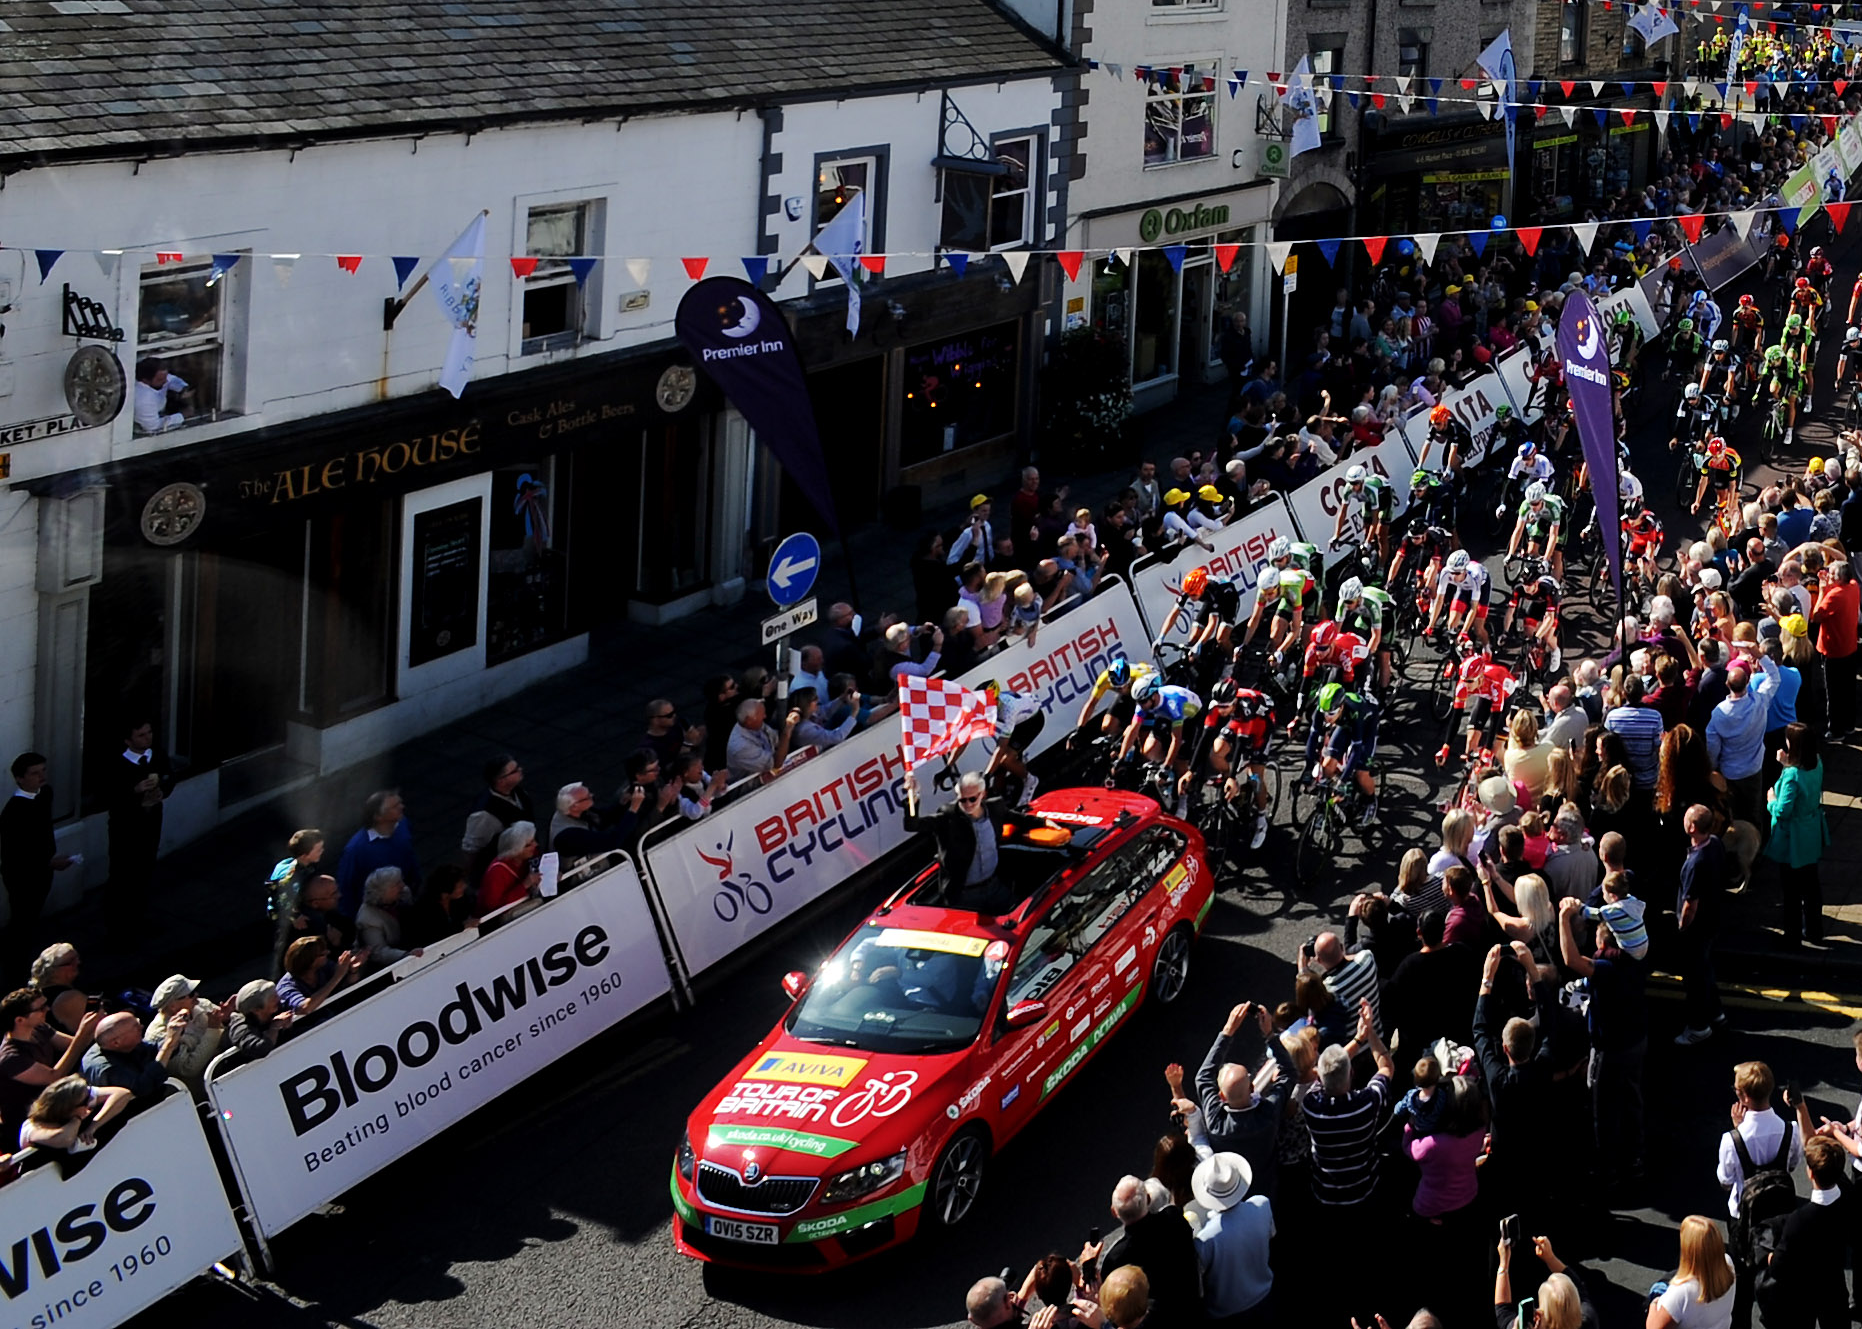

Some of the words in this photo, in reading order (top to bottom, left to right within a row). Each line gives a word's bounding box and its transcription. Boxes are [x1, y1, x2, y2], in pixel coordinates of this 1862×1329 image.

[1165, 203, 1230, 234] Oxfam
[703, 344, 757, 363] Premier
[759, 339, 784, 353] Inn
[1566, 359, 1593, 381] Premier
[1594, 369, 1608, 387] Inn
[507, 404, 543, 427] Cask
[545, 398, 577, 418] Ales
[557, 409, 598, 435] Bottle
[600, 402, 636, 423] Beers
[238, 477, 272, 500] The
[270, 457, 347, 505] ALE
[764, 618, 788, 640] One
[791, 606, 816, 628] Way
[754, 744, 905, 855] BRITISH
[988, 941, 1004, 957] A
[280, 924, 612, 1138] Bloodwise
[1093, 1002, 1128, 1045] OCTAVIA
[303, 1109, 391, 1173] Beating
[394, 1071, 453, 1120] blood
[458, 1032, 525, 1080] cancer
[528, 998, 579, 1042] since
[579, 970, 625, 1008] 1960
[783, 1061, 844, 1078] AVIVA
[733, 1083, 801, 1102] TOUR
[799, 1087, 840, 1103] OF
[713, 1096, 827, 1122] BRITAIN
[726, 1128, 827, 1153] skoda.co.uk/cycling
[713, 1219, 744, 1239] OV15
[746, 1223, 774, 1243] SZR
[31, 1279, 104, 1329] since
[109, 1233, 174, 1284] 1960
